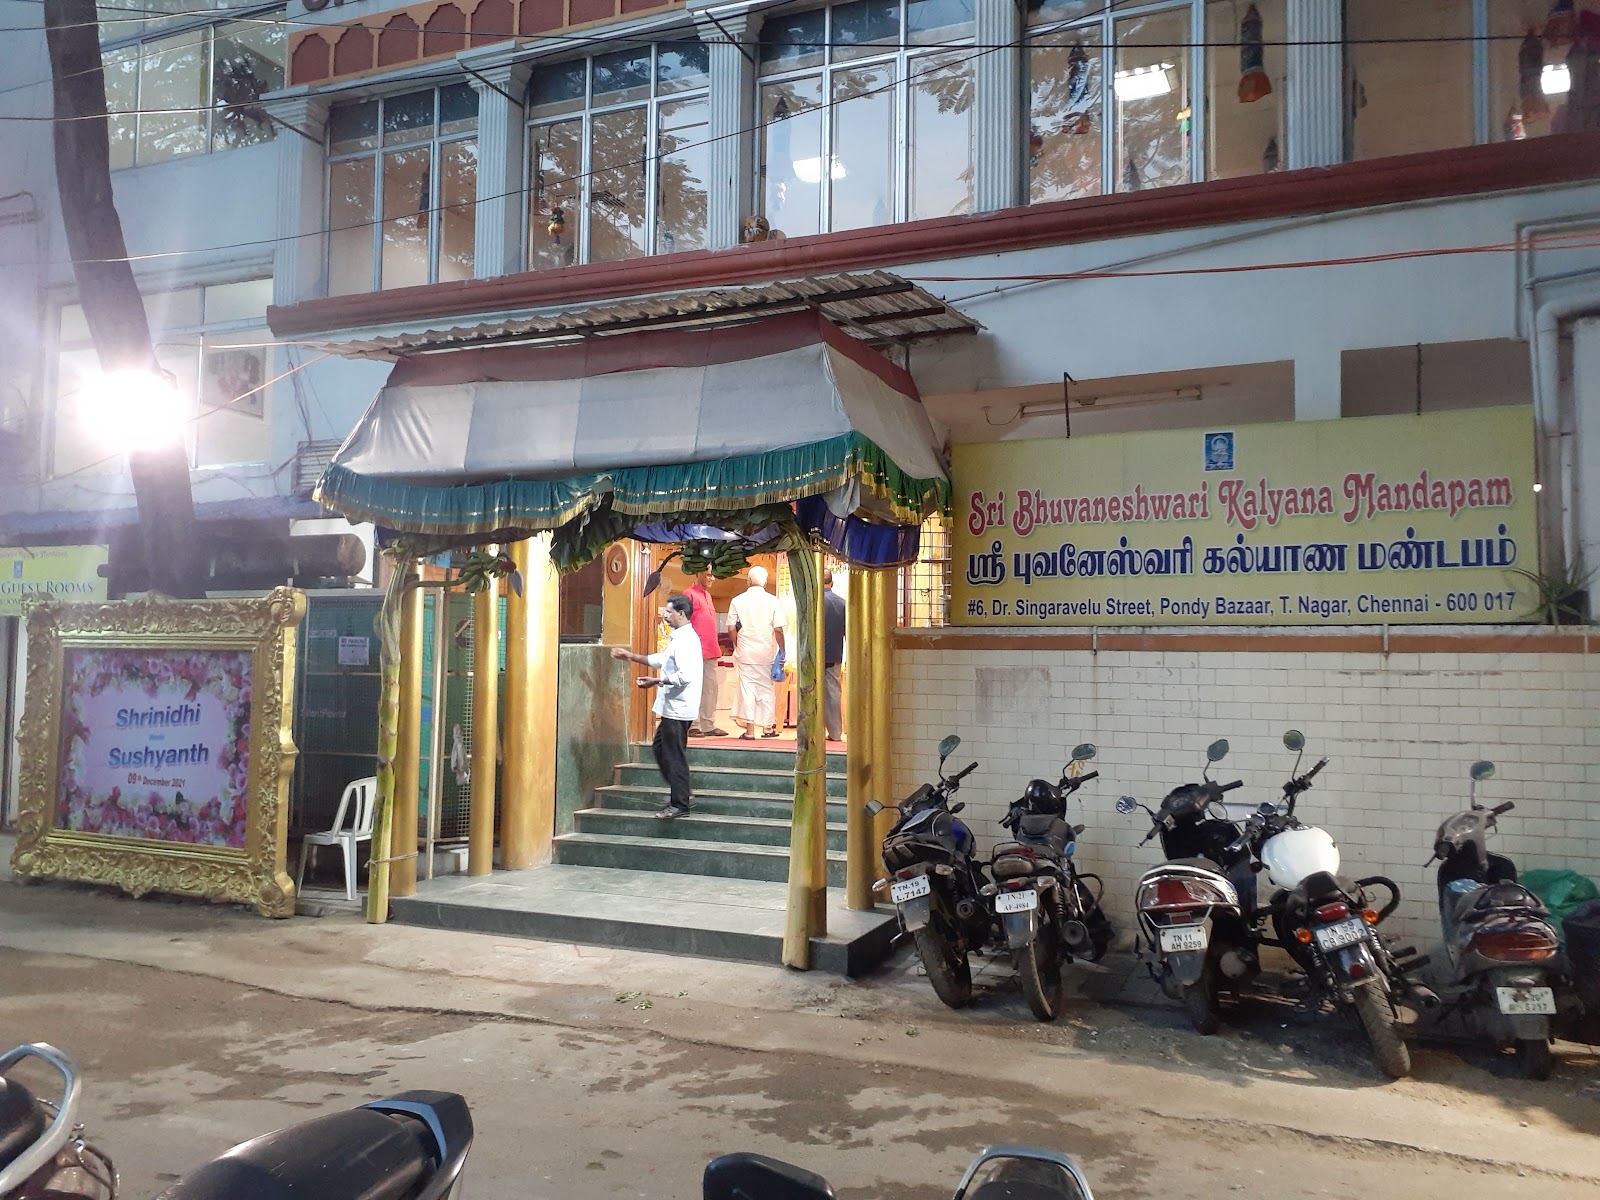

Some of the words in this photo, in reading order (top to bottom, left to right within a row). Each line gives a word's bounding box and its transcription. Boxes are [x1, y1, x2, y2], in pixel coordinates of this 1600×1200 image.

[968, 491, 1005, 536] Sri
[1013, 481, 1209, 536] Bhuvaneshwari
[1218, 478, 1334, 530] Kalyana
[1343, 470, 1513, 522] Mandapam
[1013, 536, 1193, 584] புவனேஸ்வரி
[1203, 533, 1348, 574] கல்யாண
[1357, 524, 1517, 570] மண்டபம்
[46, 581, 94, 594] ROOMS
[967, 599, 988, 618] #6,
[992, 599, 1011, 616] Dr.
[1015, 598, 1101, 620] Singaravelu
[1106, 597, 1155, 617] Street,
[1160, 597, 1210, 619] Pondy
[1215, 596, 1274, 616] Bazaar,
[1279, 595, 1292, 614] T.
[1298, 595, 1351, 618] Nagar,
[1357, 594, 1429, 613] Chennai
[1446, 592, 1478, 612] 600
[1484, 591, 1517, 611] 017
[116, 703, 201, 728] Shrinidhi
[108, 743, 209, 771] Sushyanth
[1173, 934, 1183, 942] TN
